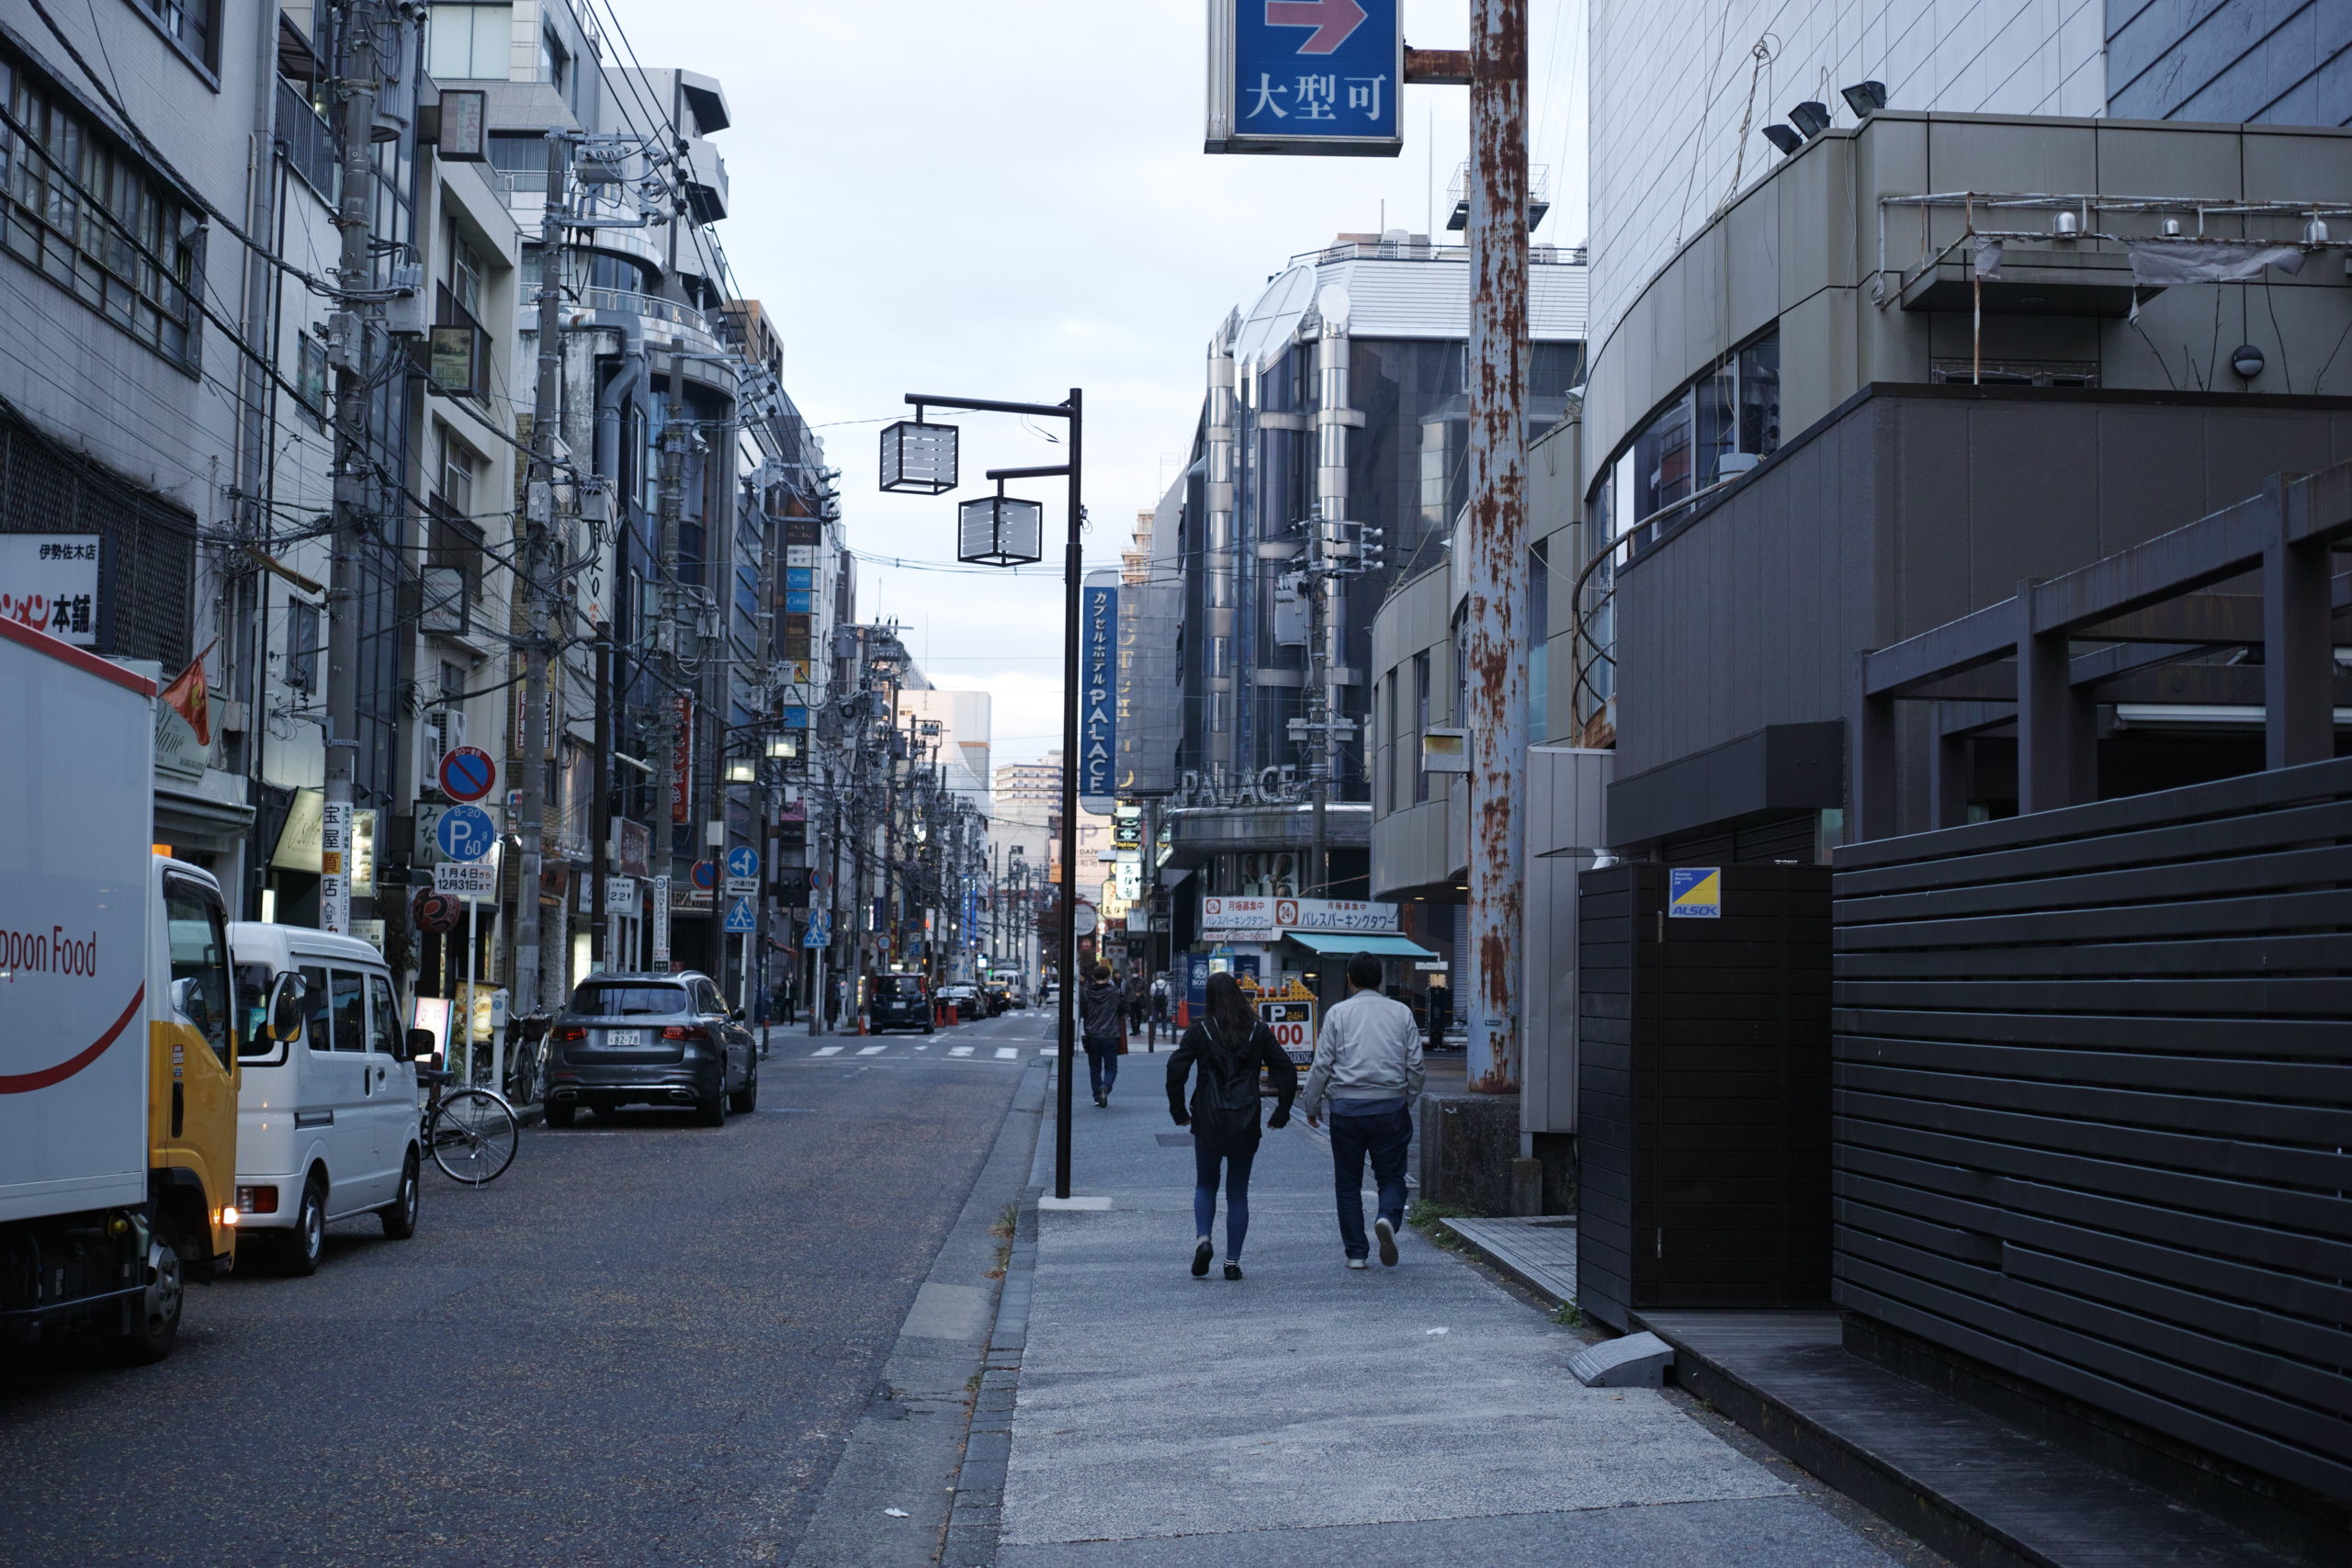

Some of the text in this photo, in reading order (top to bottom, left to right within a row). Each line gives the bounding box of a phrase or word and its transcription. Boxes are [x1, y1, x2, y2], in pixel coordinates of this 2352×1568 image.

[1245, 73, 1386, 120] 大型可
[40, 544, 96, 560] 伊勢佐木店
[1088, 689, 1109, 795] PALACE
[1182, 763, 1304, 807] PALACE
[455, 808, 481, 818] 8-20
[450, 821, 471, 855] P
[322, 805, 340, 897] 宝屋質店
[441, 868, 492, 879] 1月4日から
[437, 879, 492, 890] 12月31日まで
[1328, 901, 1367, 910] 月極募集中
[1672, 906, 1718, 916] ALSOK
[1282, 907, 1294, 919] 24h
[1302, 911, 1395, 929] パレスパーキングタワー
[1205, 916, 1269, 926] パレスパーキングタワー
[1232, 932, 1267, 941] 252-5001
[52, 925, 96, 977] Food
[1271, 1005, 1304, 1021] P 24H
[615, 1036, 639, 1044] 82-78
